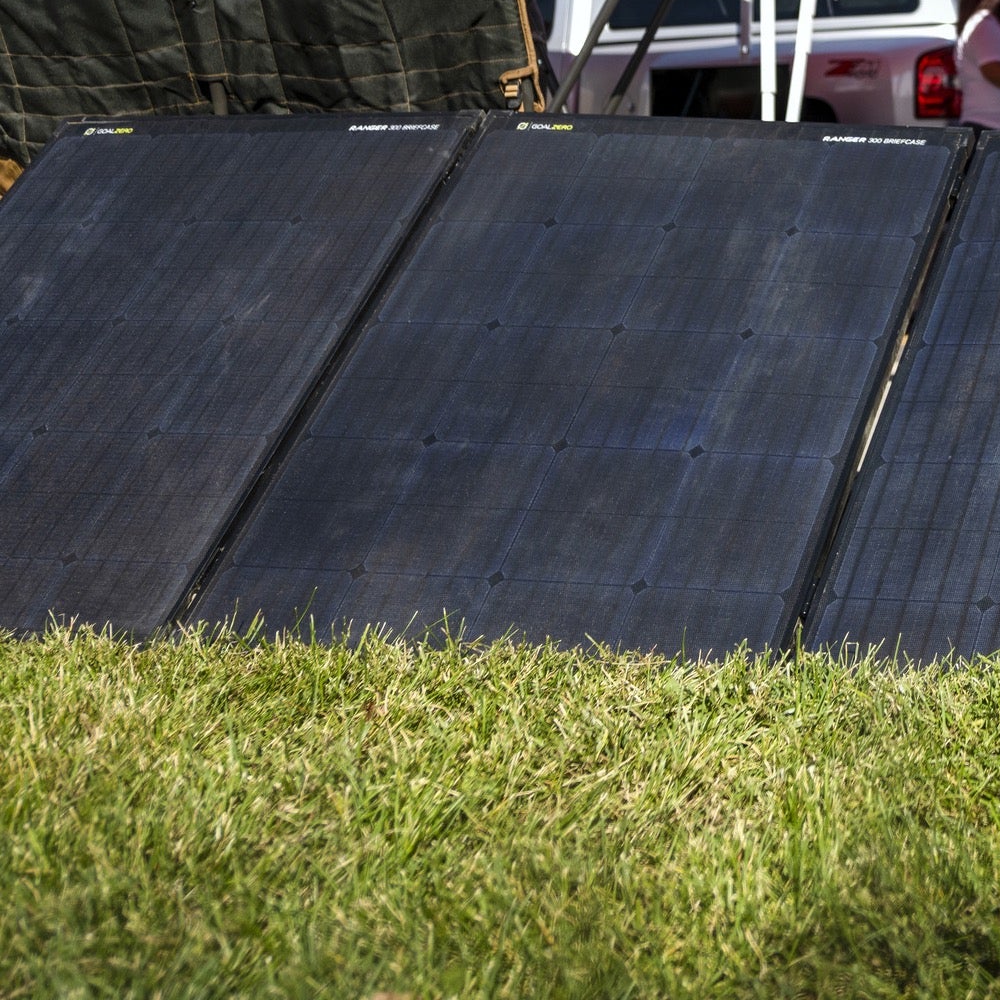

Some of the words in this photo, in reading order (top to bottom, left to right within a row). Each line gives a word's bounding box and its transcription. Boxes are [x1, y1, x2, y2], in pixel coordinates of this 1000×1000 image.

[348, 124, 388, 132] RANGER
[822, 135, 867, 143] RANGER
[883, 138, 927, 146] BRIEFCASE
